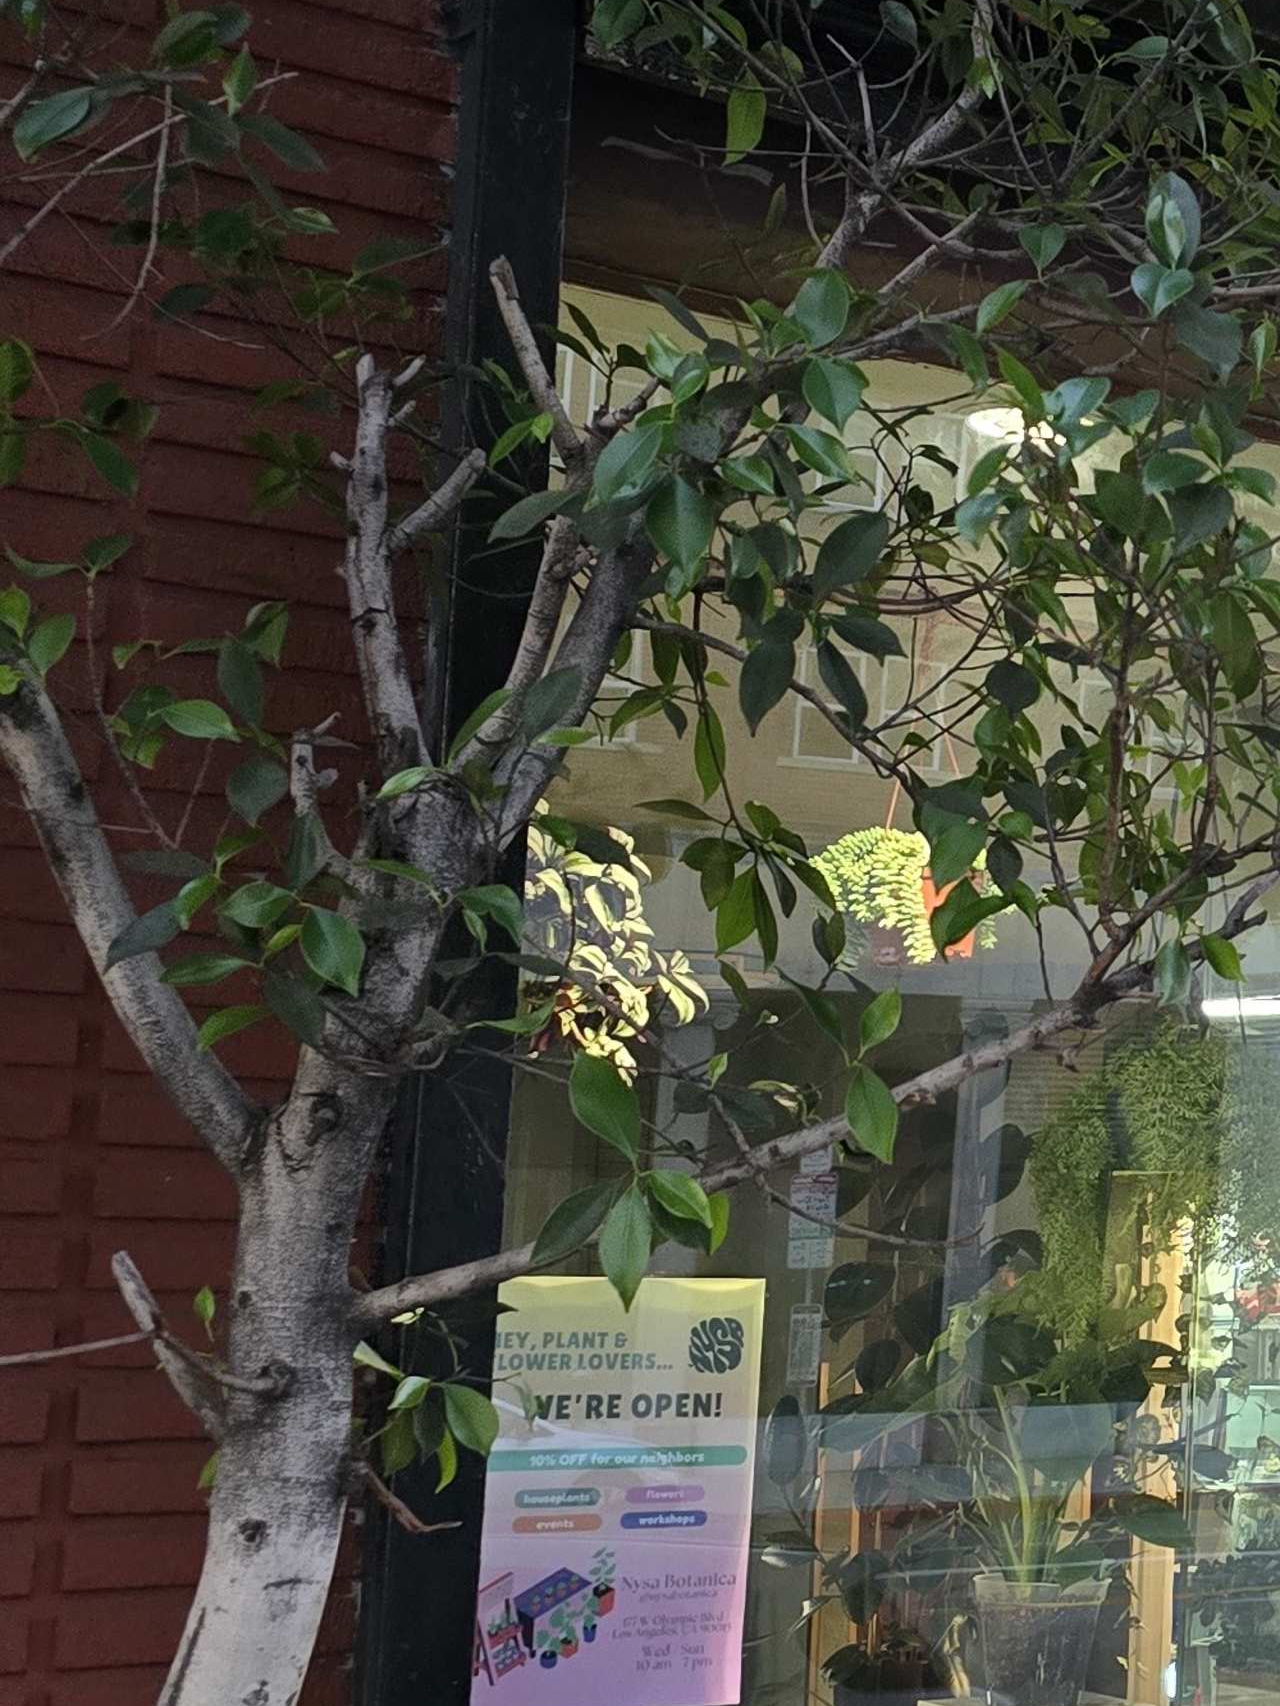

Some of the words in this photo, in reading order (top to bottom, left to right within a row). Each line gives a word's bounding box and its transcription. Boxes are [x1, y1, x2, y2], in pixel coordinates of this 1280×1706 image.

[542, 1331, 609, 1349] PLANT
[614, 1331, 628, 1349] &
[495, 1353, 572, 1371] LOWER
[577, 1353, 673, 1371] LOVERS...
[631, 1392, 723, 1419] OPEN!
[529, 1454, 556, 1468] 10%
[558, 1453, 588, 1466] OFF
[591, 1452, 613, 1465] for
[614, 1454, 638, 1464] our
[640, 1451, 705, 1467] neighbors
[523, 1493, 591, 1505] houseplants
[536, 1519, 575, 1531] events
[638, 1513, 695, 1527] workshops
[622, 1576, 660, 1594] Nysa
[664, 1573, 737, 1589] Botanica
[642, 1644, 672, 1657] Wed
[681, 1643, 705, 1655] Sun
